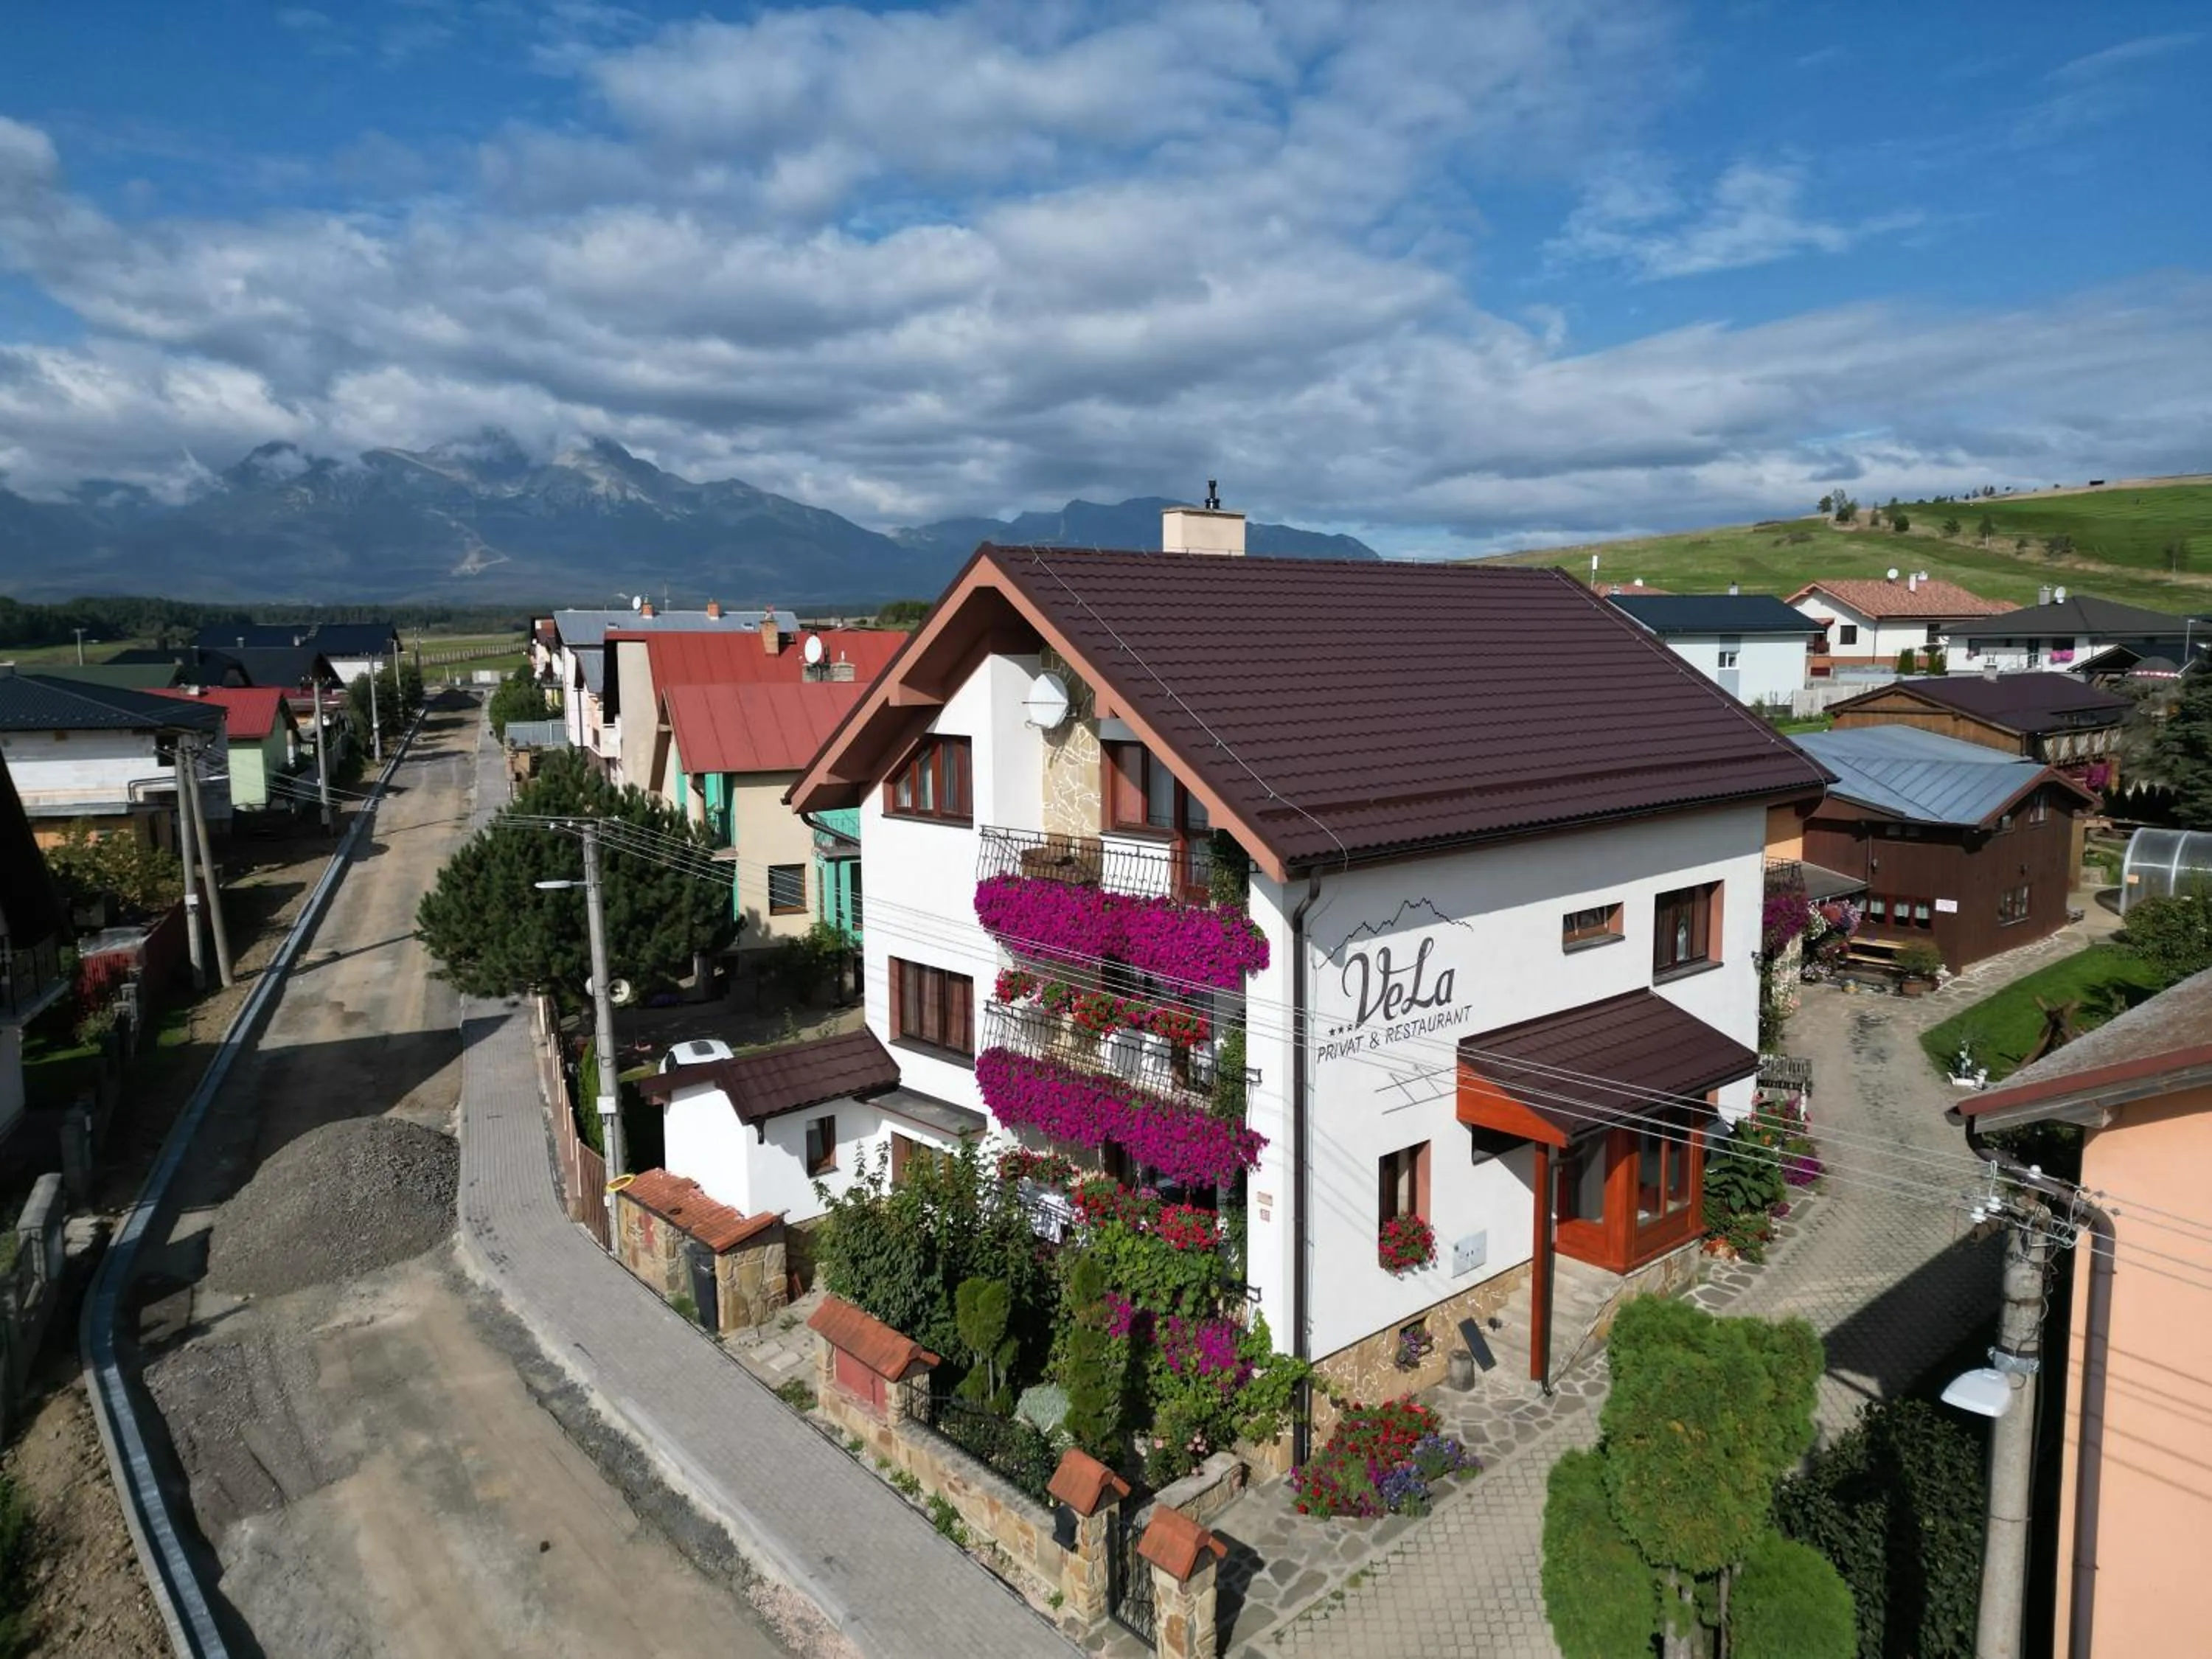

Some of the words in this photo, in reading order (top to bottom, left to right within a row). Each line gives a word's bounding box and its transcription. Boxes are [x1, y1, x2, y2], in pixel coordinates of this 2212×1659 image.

[1341, 936, 1455, 1029] VeLa
[1317, 1035, 1364, 1064] PRIVAT
[1369, 1031, 1380, 1050] &
[1385, 1004, 1472, 1045] RESTAURANT
